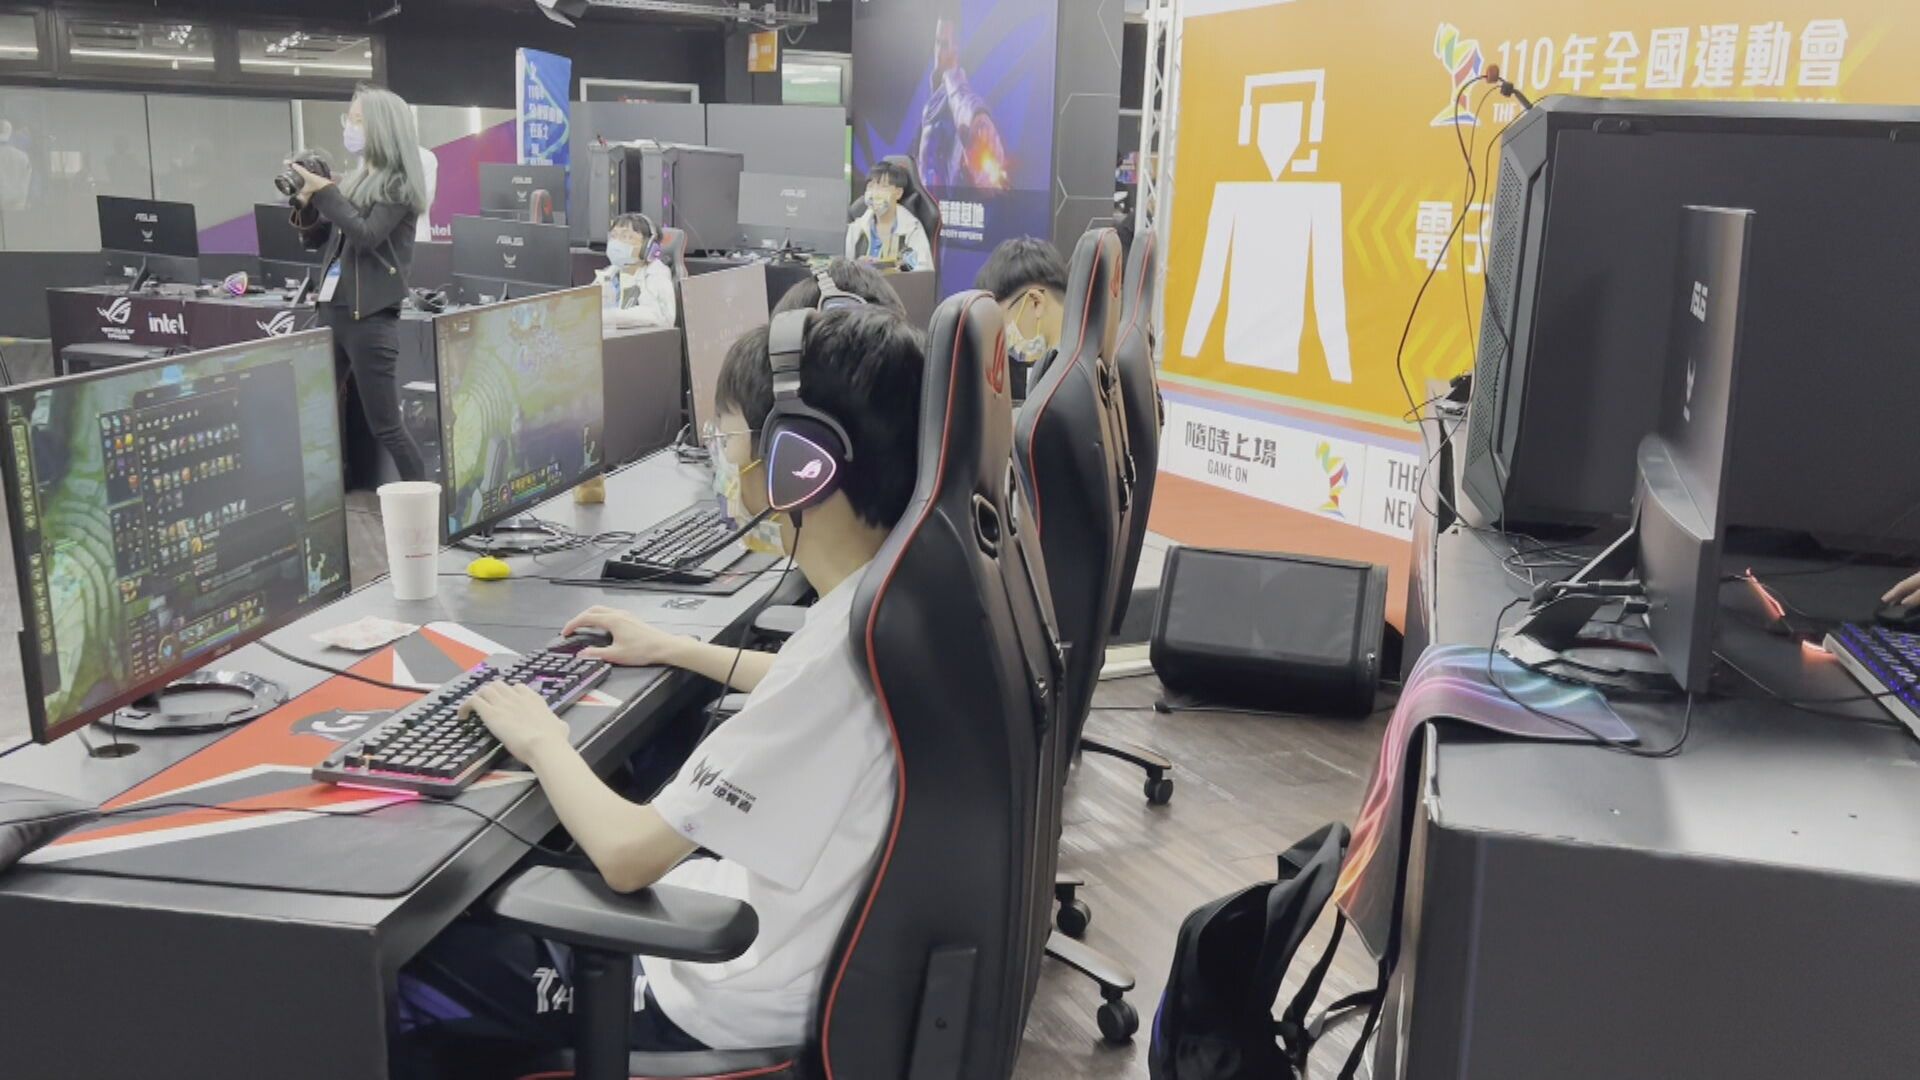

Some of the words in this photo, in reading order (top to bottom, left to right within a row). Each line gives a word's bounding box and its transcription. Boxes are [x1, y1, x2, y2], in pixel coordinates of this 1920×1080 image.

[1497, 18, 1849, 91] 110年全國運動會
[430, 223, 452, 236] ntel
[496, 234, 524, 247] ASUS
[1414, 200, 1491, 273] 電子
[1184, 420, 1278, 469] 隨時上場
[1207, 459, 1235, 480] GAME
[1235, 466, 1249, 484] ON
[1387, 458, 1419, 493] THE
